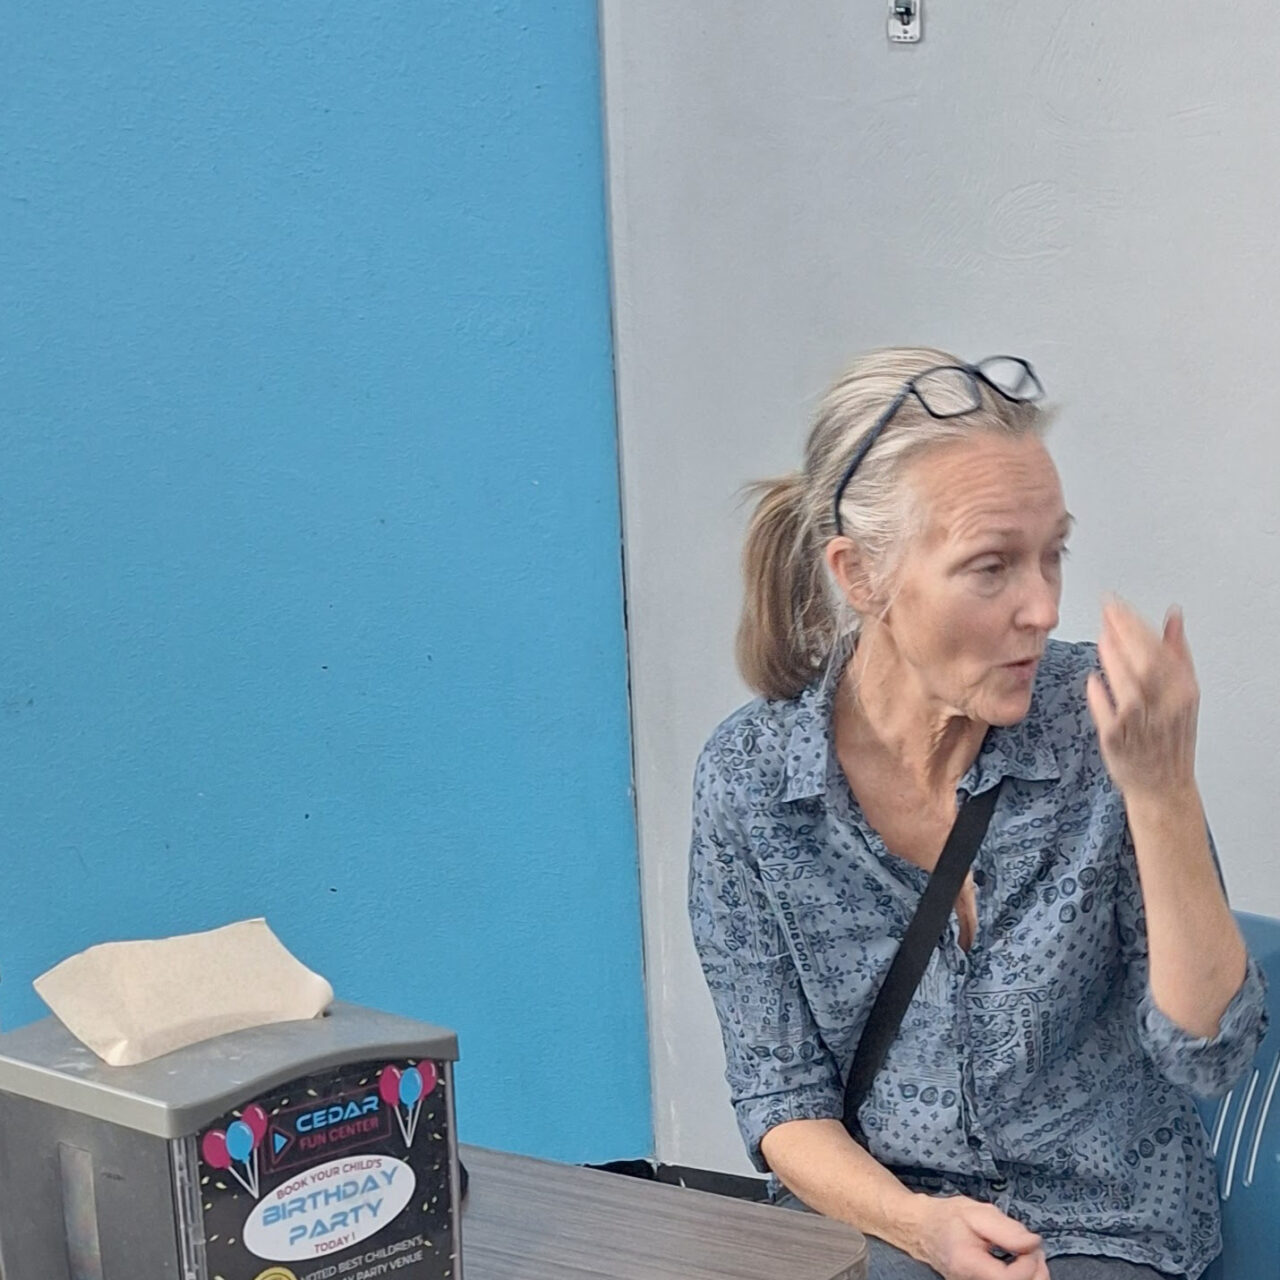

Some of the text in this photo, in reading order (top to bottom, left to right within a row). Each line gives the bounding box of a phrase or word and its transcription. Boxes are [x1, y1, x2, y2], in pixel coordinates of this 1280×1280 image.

[296, 1096, 379, 1132] CEDAR
[300, 1117, 379, 1149] FUN CENTER
[262, 1165, 399, 1226] BIRTHDAY
[276, 1158, 383, 1200] BOOK YOUR CHILD'S
[289, 1198, 384, 1246] PARTY
[338, 1255, 363, 1273] BEST
[389, 1250, 424, 1270] VENUE
